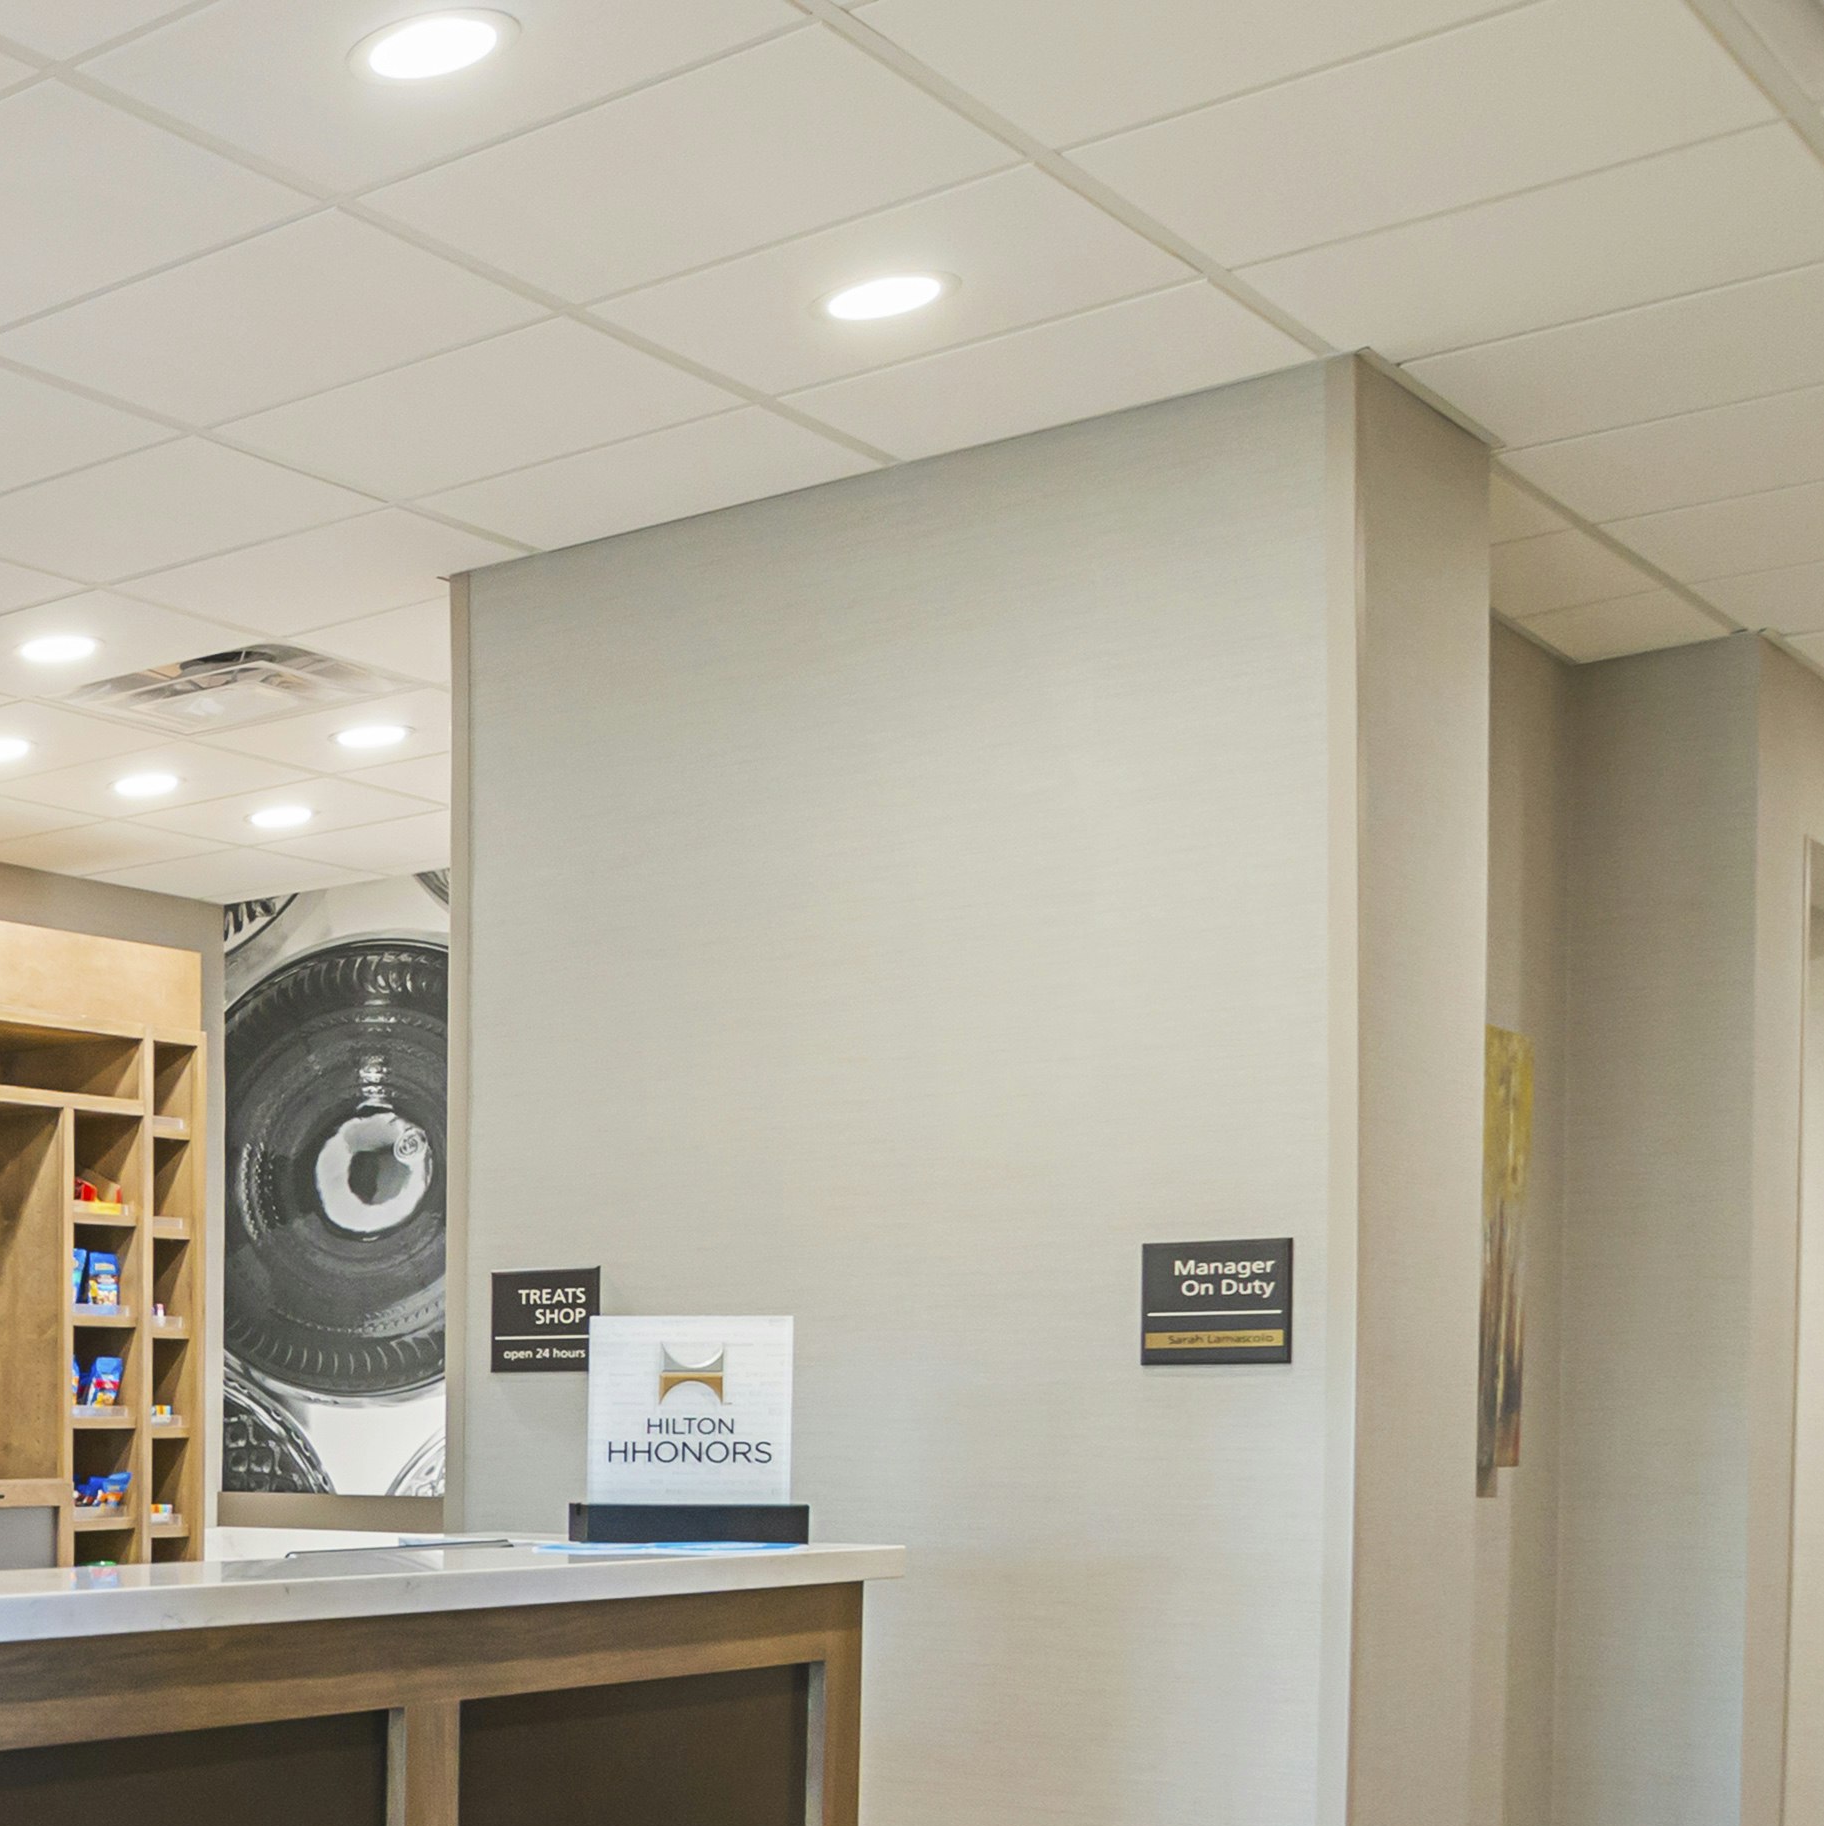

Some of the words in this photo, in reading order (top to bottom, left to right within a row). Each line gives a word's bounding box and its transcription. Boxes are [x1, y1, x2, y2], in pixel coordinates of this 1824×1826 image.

[1174, 1260, 1276, 1278] Manager
[518, 1287, 586, 1305] TREATS
[1181, 1280, 1214, 1296] On
[1221, 1279, 1276, 1298] Duty
[535, 1308, 586, 1325] SHOP
[1167, 1334, 1204, 1345] Sarah
[503, 1350, 533, 1361] open
[535, 1348, 550, 1359] 24
[552, 1347, 586, 1359] hours
[646, 1417, 735, 1435] HILTON
[608, 1441, 773, 1463] HHONORS
